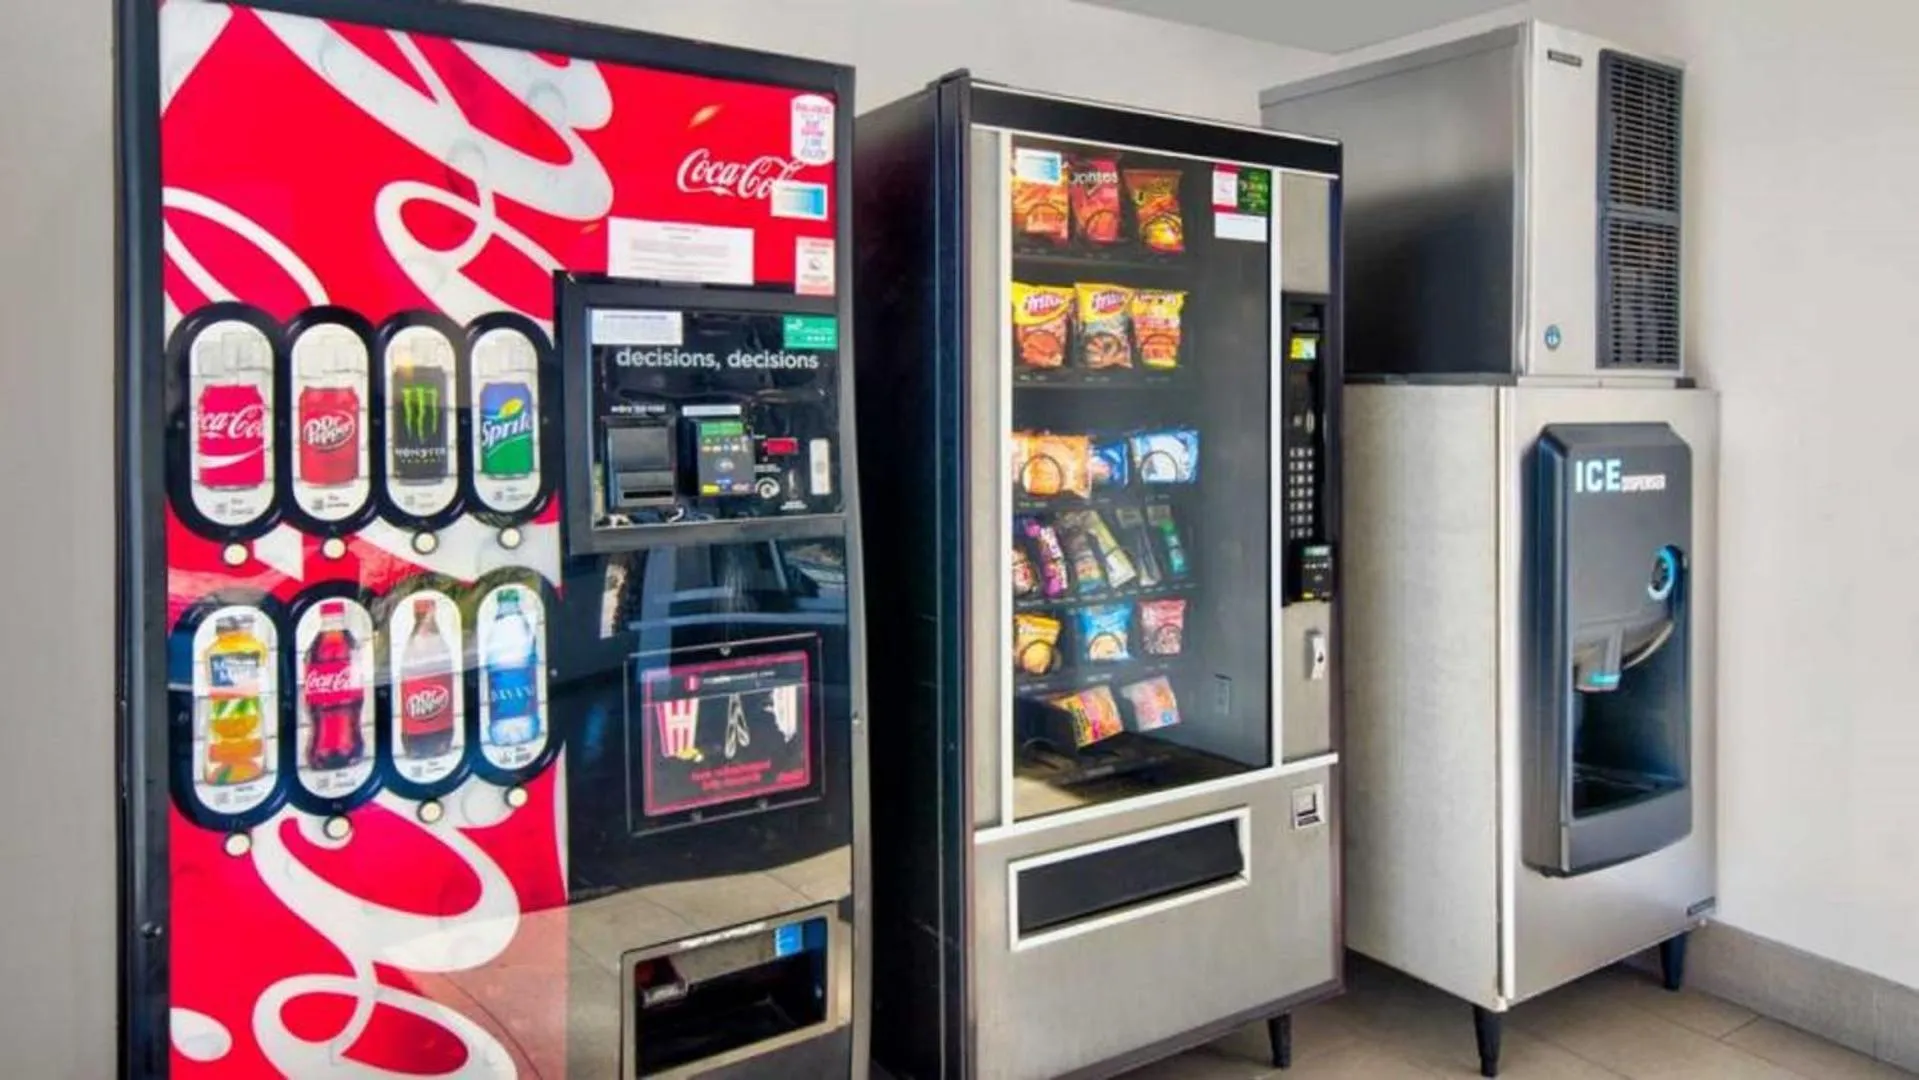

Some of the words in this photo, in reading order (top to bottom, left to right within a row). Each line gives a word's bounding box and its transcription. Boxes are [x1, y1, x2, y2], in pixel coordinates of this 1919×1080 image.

[676, 147, 806, 200] Coca-Col
[616, 347, 721, 370] decisions,
[727, 349, 819, 369] decisions
[1575, 459, 1621, 492] ICE
